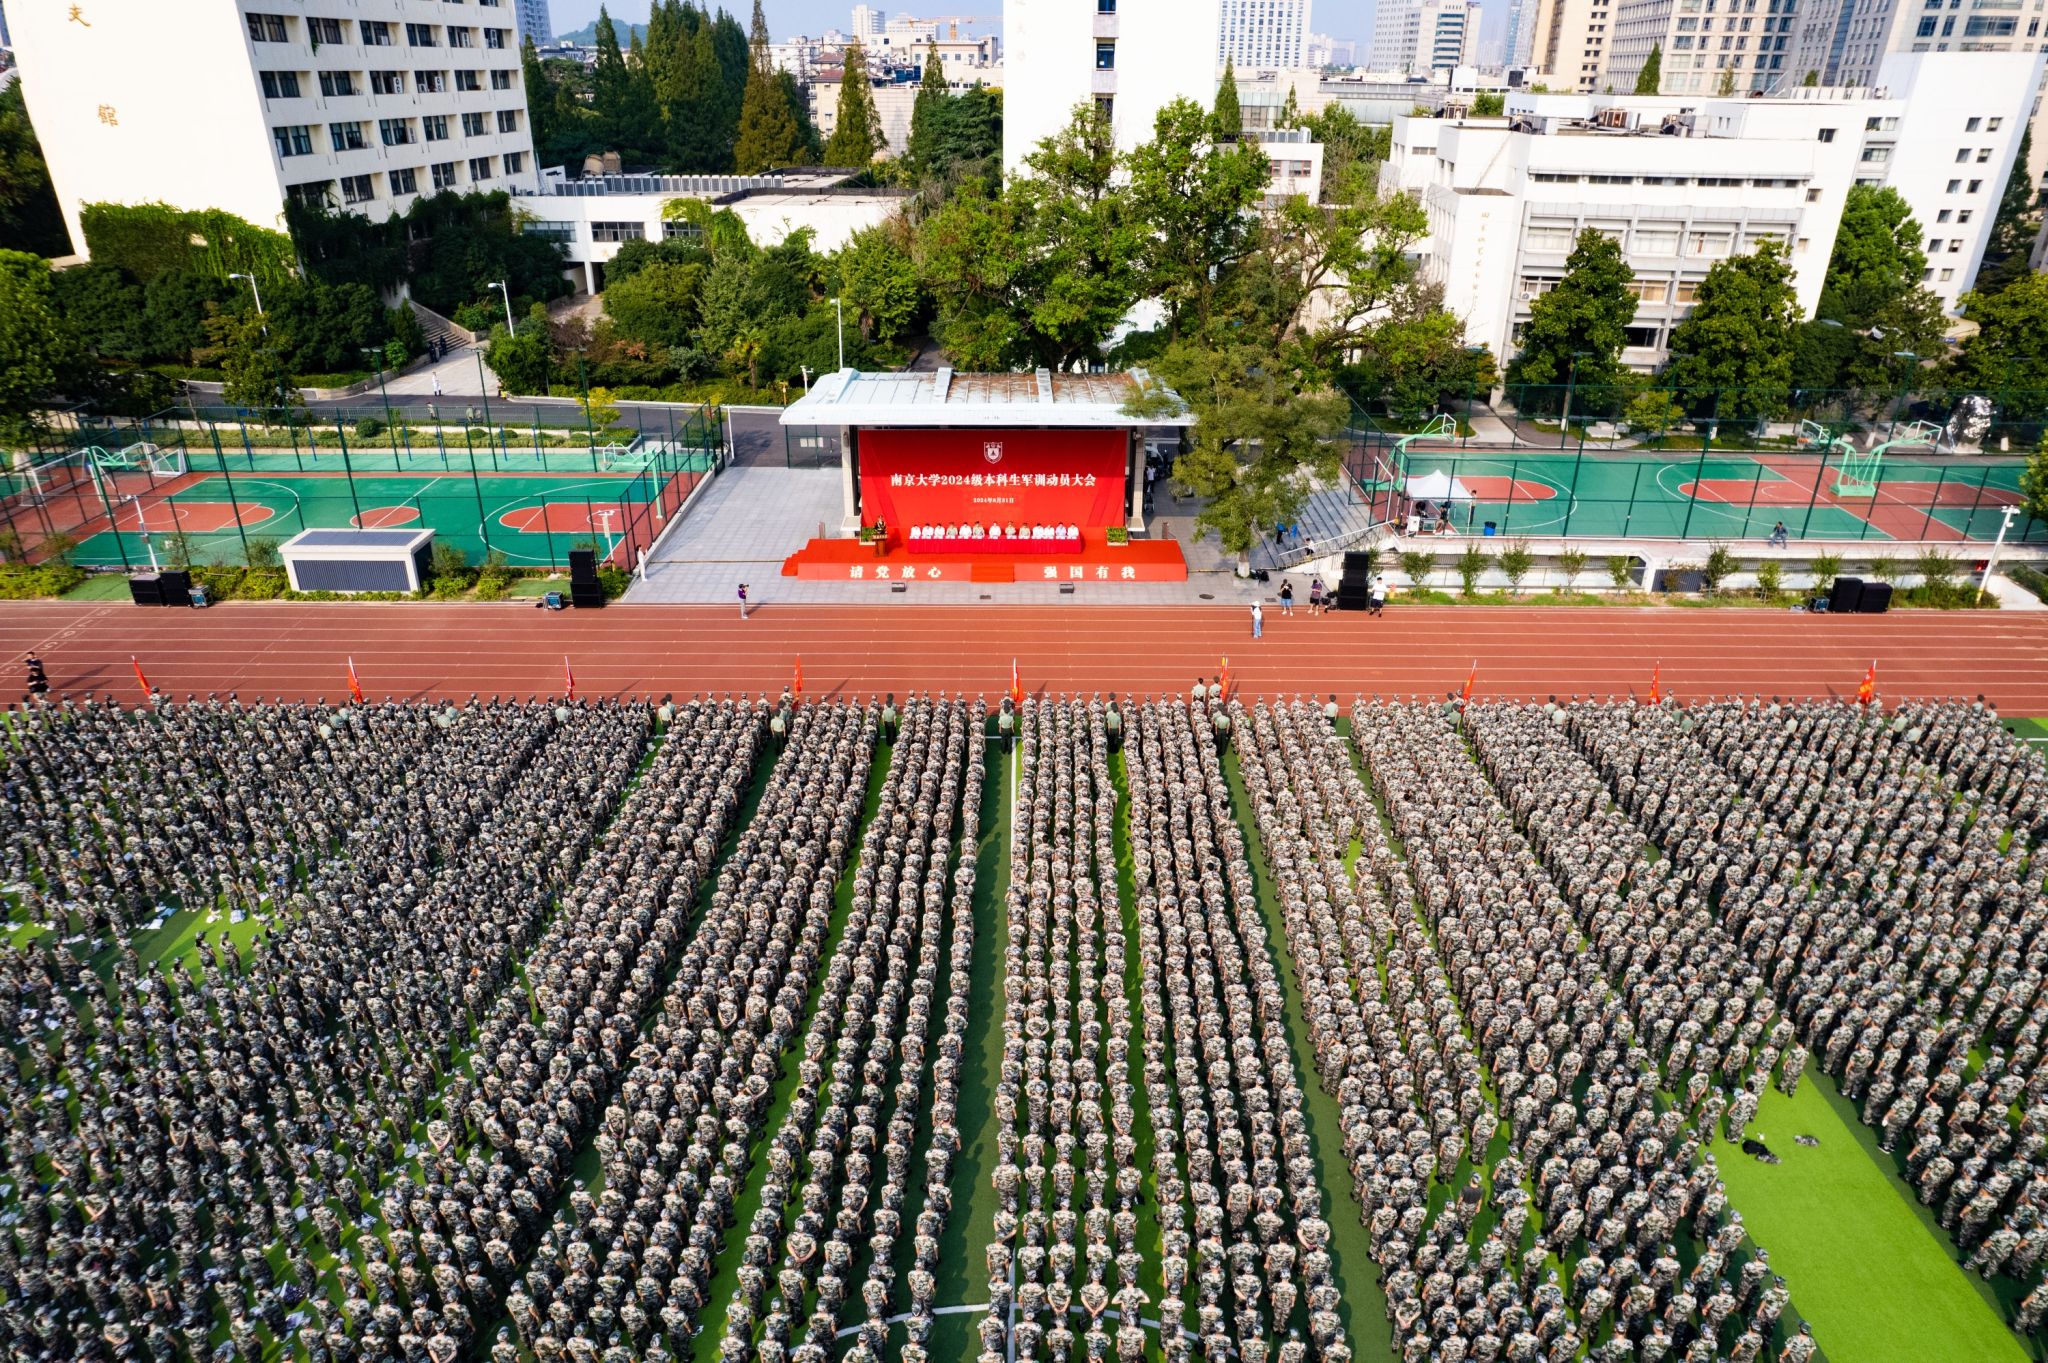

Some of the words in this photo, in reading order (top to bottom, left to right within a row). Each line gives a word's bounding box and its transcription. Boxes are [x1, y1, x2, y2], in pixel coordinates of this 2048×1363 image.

[890, 473, 1096, 487] 南京大学2024级本科生军训动员大会
[849, 565, 941, 579] 请党放心
[1043, 565, 1136, 579] 强国有我
